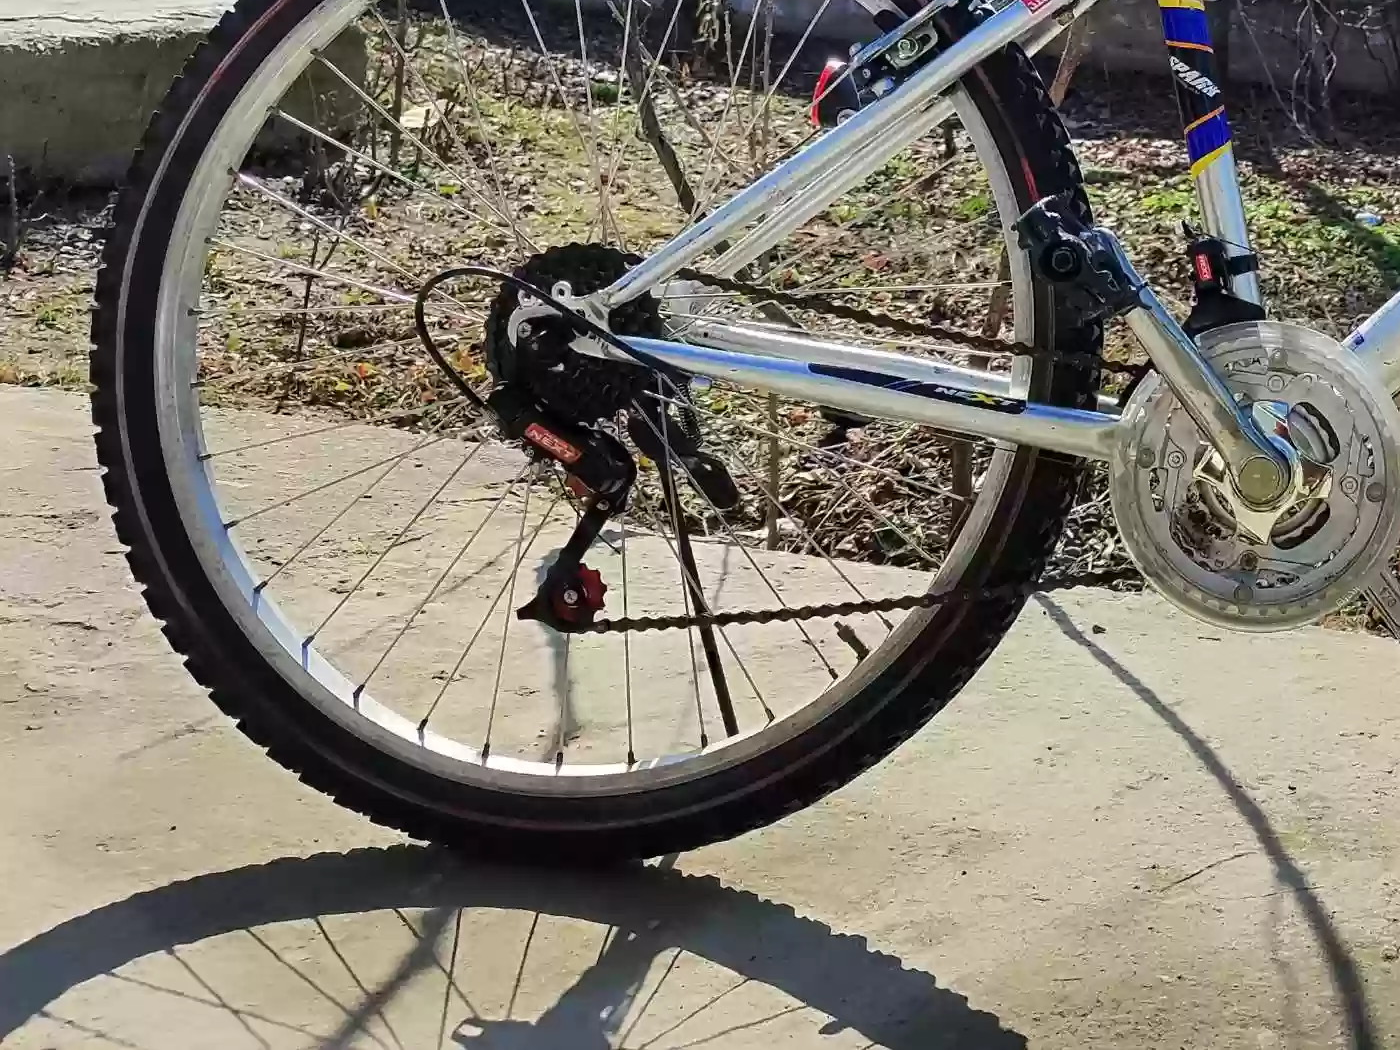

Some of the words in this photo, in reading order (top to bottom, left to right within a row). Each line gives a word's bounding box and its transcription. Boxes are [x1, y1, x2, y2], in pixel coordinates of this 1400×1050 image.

[1168, 54, 1221, 98] SPARK
[933, 386, 1018, 407] NEXT
[529, 429, 576, 458] NEXT
